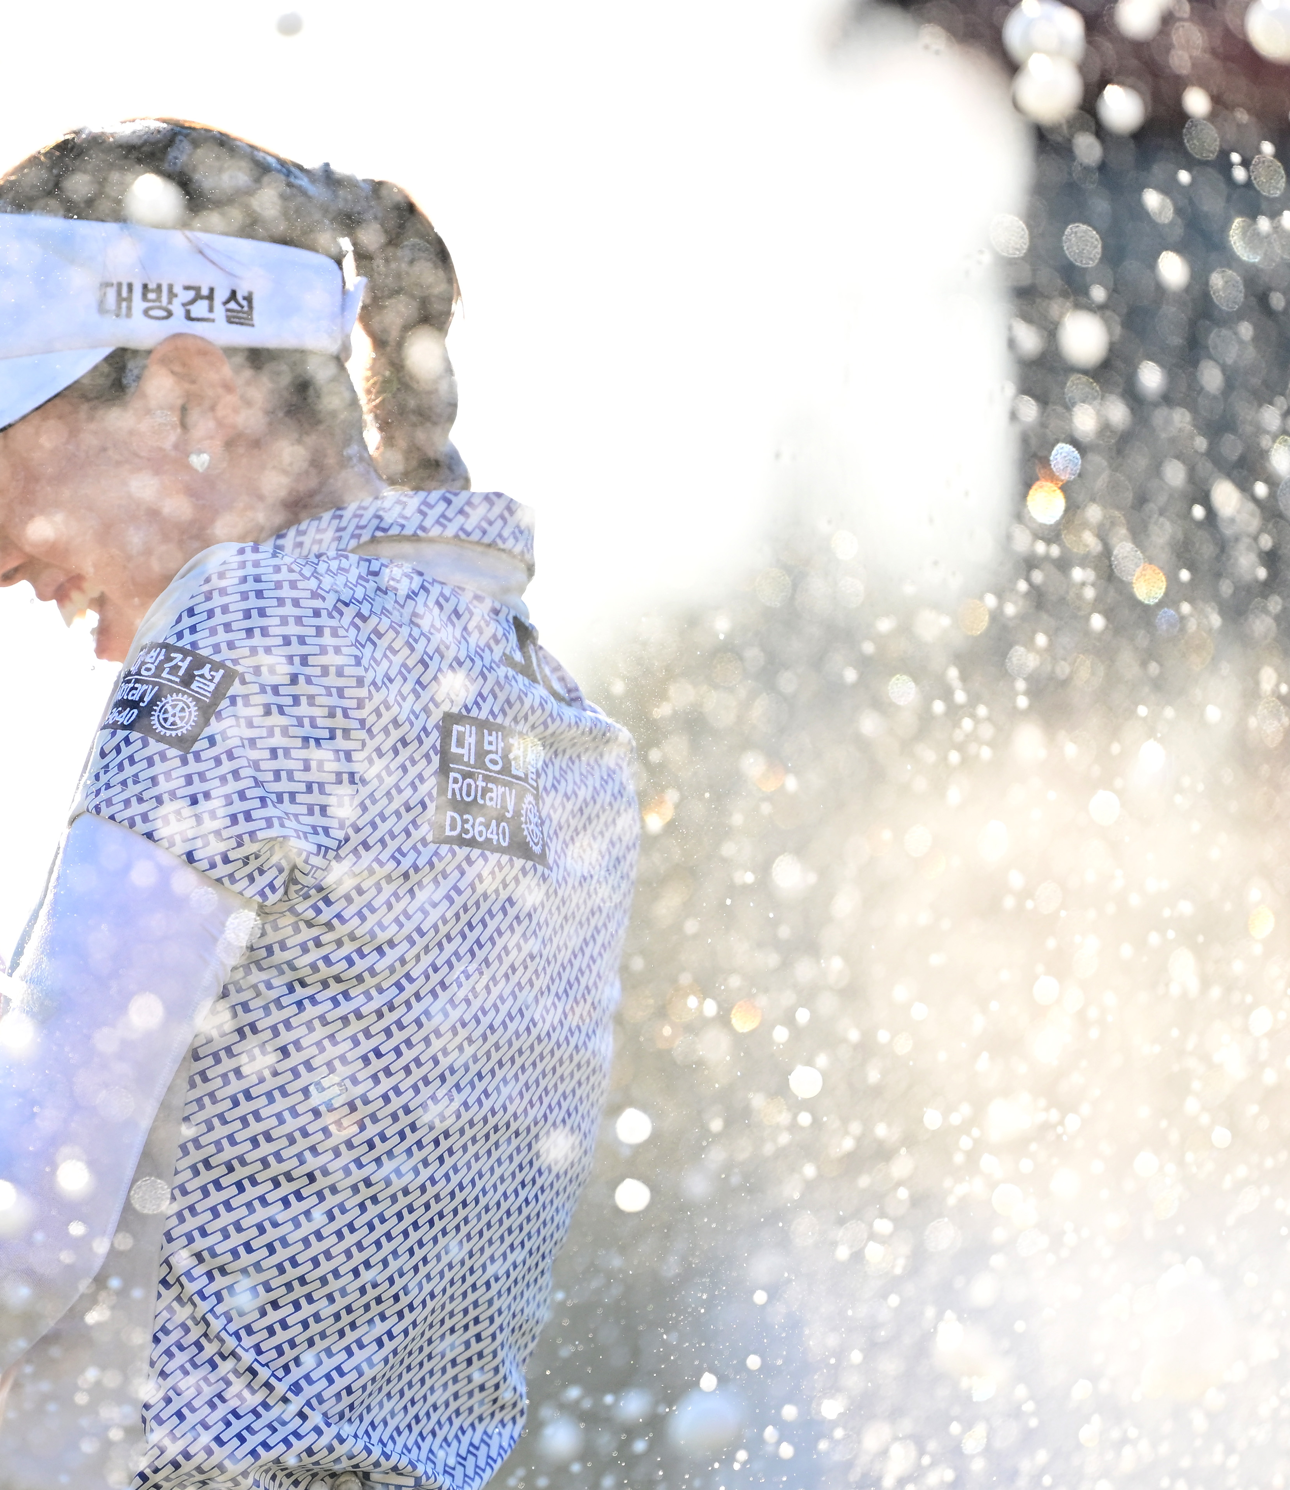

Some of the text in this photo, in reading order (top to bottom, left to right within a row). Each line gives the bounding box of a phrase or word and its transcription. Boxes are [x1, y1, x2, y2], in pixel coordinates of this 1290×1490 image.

[99, 280, 256, 328] 대방건설
[117, 678, 159, 707] otary
[447, 772, 517, 818] Rotary
[445, 811, 510, 847] D3640
